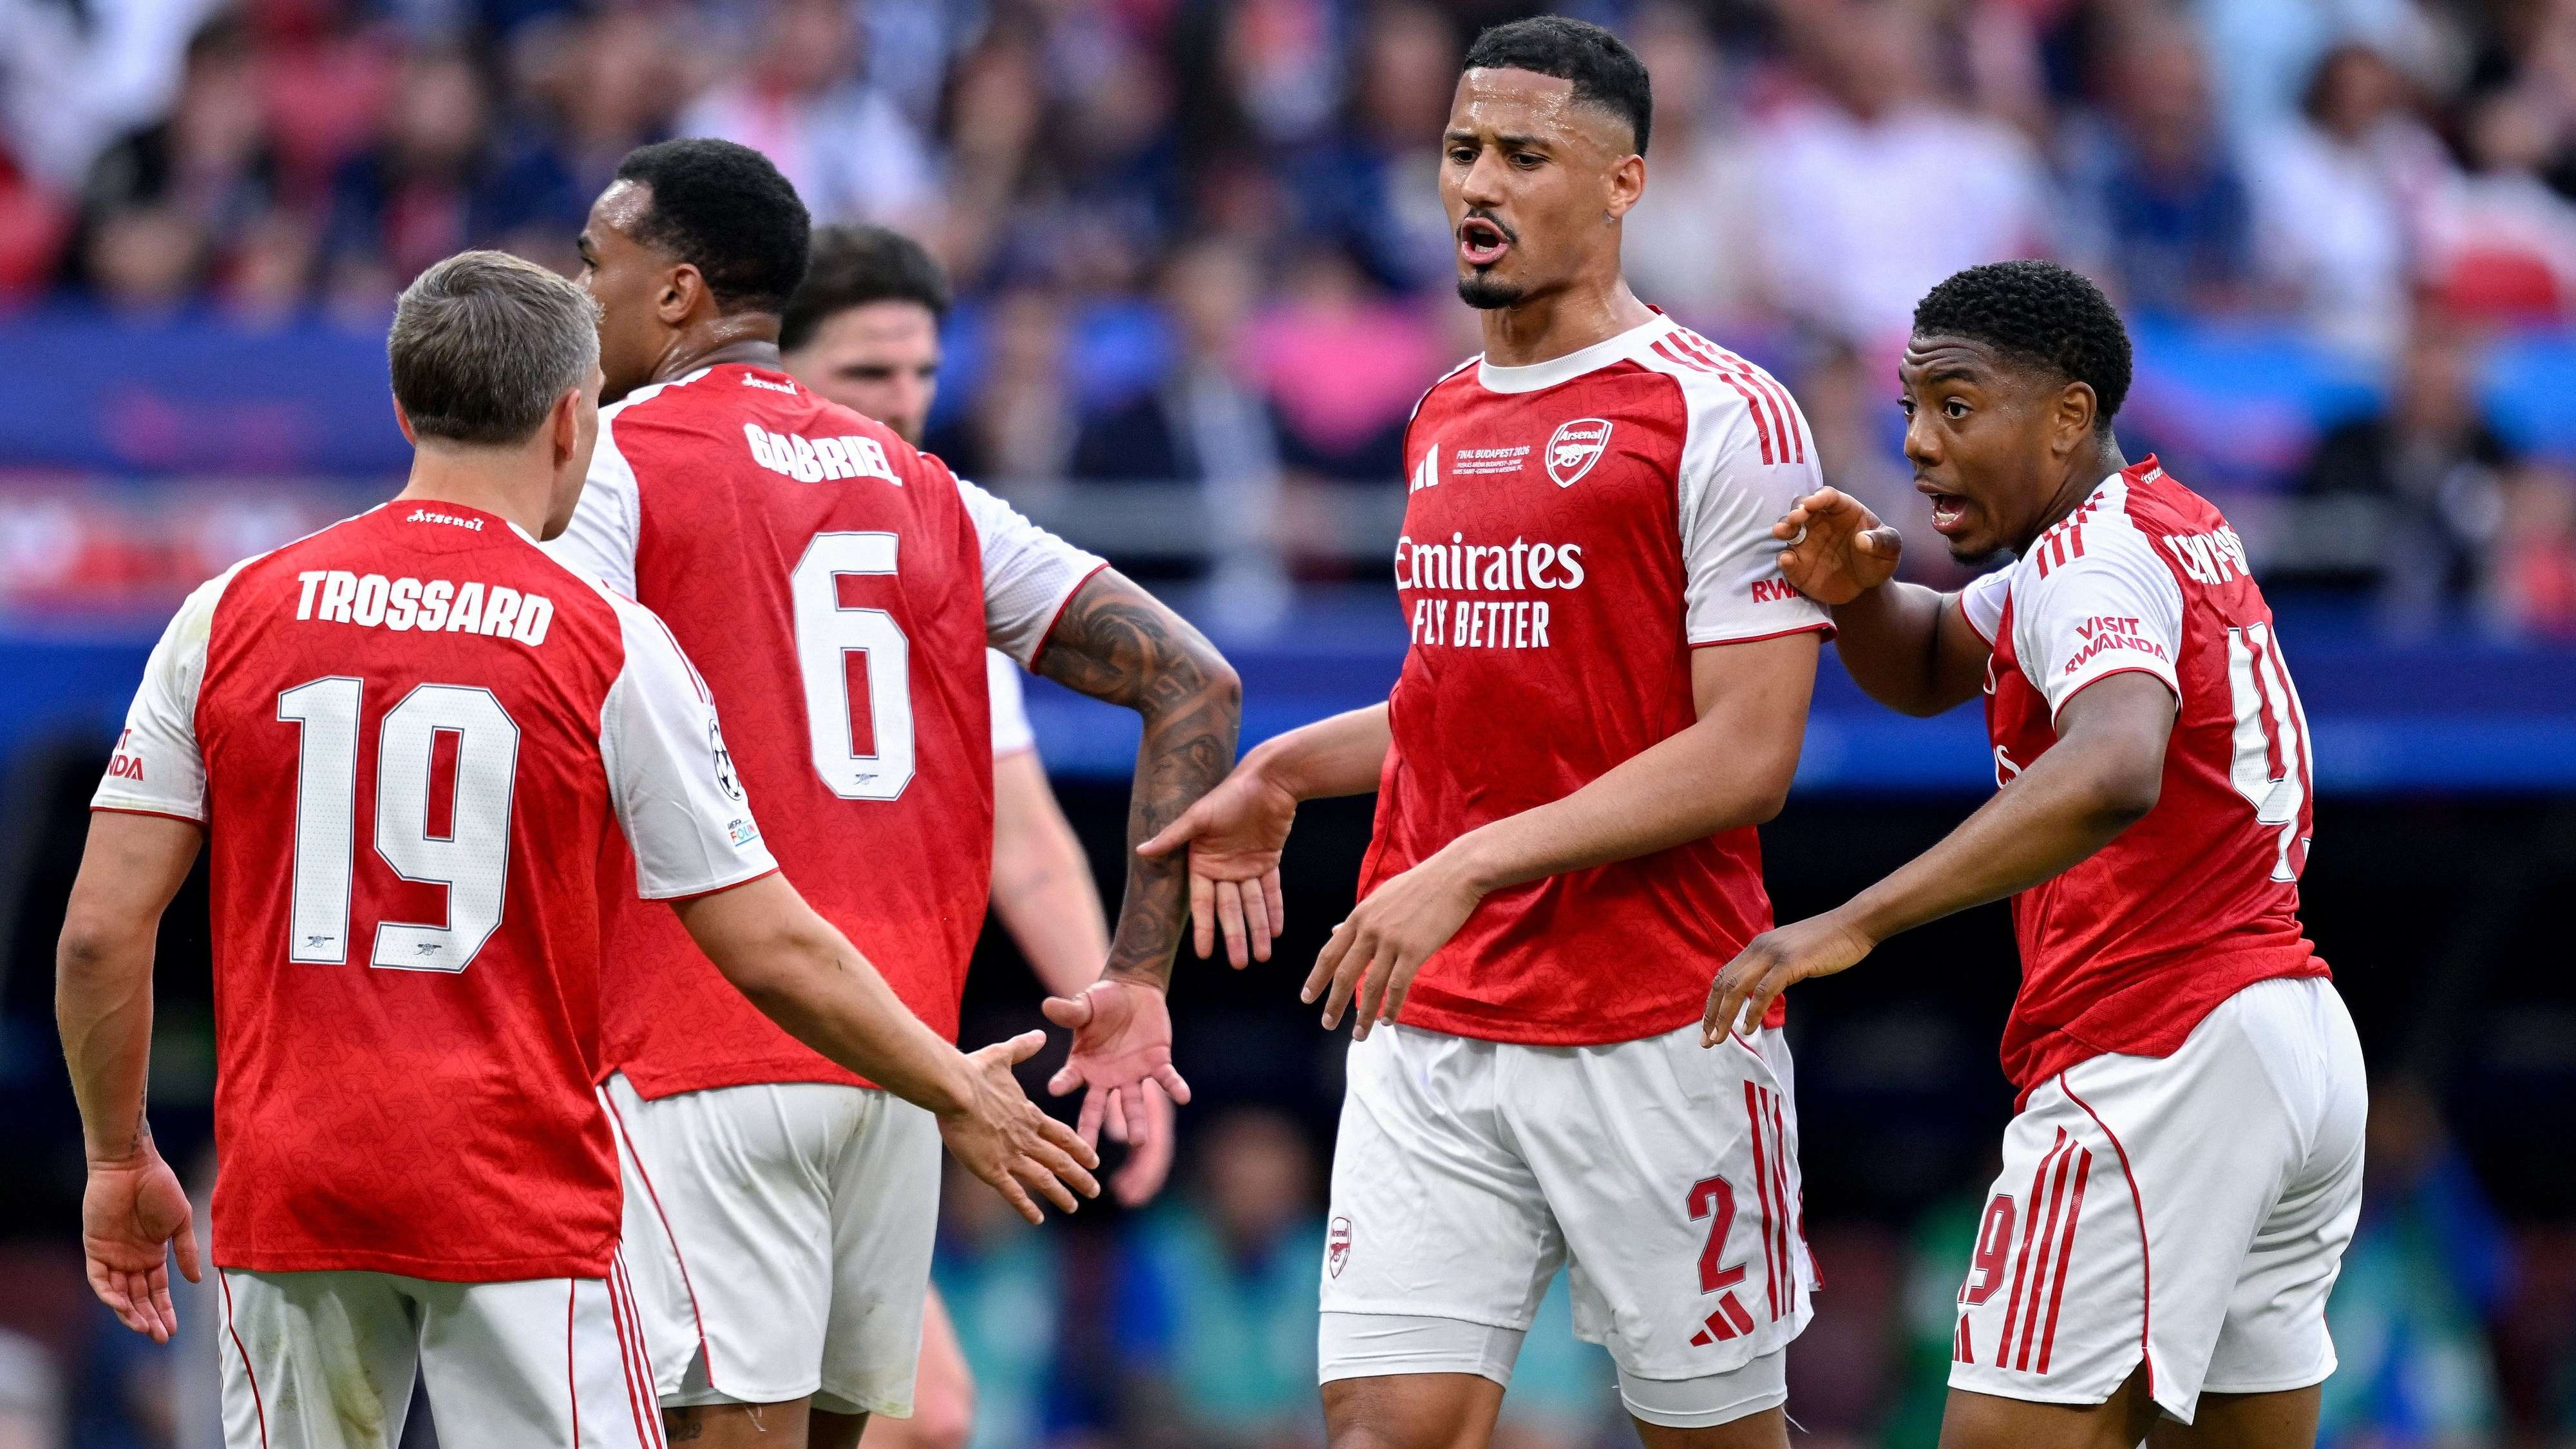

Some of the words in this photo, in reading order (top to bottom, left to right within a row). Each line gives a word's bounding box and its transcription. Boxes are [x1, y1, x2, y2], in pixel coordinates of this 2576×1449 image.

[743, 422, 903, 487] GABRIEL
[1457, 450, 1475, 459] FINAL
[1475, 448, 1515, 459] BUDAPEST
[1513, 445, 1530, 456] 2026
[1558, 429, 1602, 441] Arsenal
[406, 509, 484, 531] Arsenal
[1395, 531, 1585, 591] Emirates
[297, 571, 553, 647] TROSSARD
[1412, 599, 1448, 645] FLY
[1454, 601, 1549, 649] BETTER
[2075, 616, 2139, 640] VISIT
[791, 531, 916, 801] 6
[2065, 633, 2169, 676] RWANDA
[2228, 616, 2313, 884] 4
[277, 674, 520, 974] 19
[1685, 1175, 1747, 1295] 2
[1958, 1193, 2017, 1306] 9
